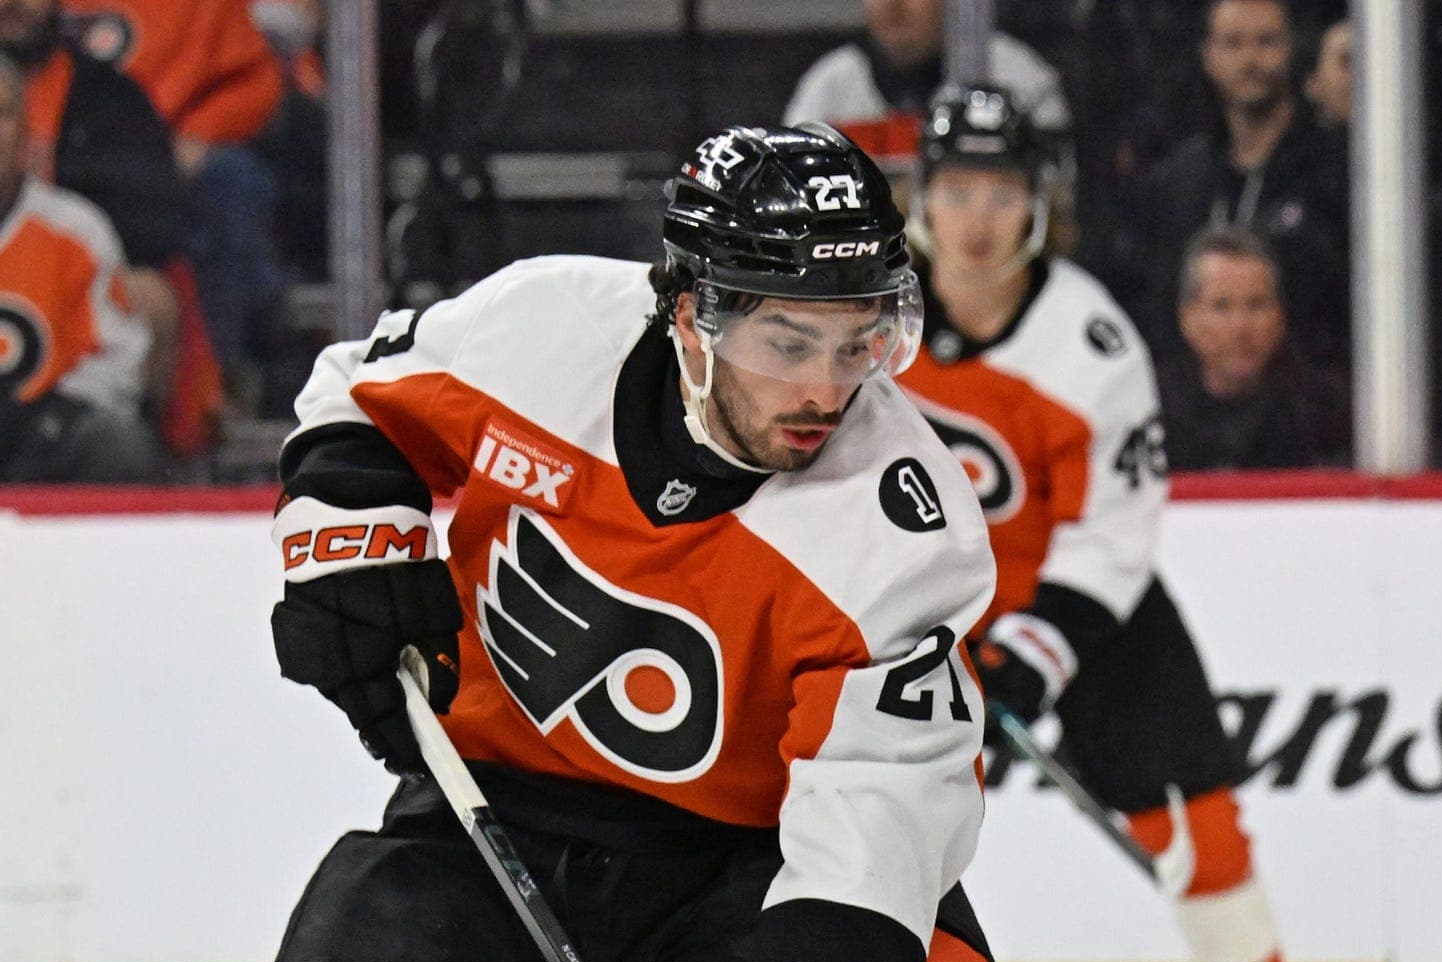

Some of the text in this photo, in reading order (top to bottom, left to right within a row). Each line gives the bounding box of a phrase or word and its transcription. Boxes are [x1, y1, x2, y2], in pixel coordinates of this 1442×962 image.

[808, 174, 861, 211] 27
[812, 241, 880, 260] CCM
[487, 423, 562, 468] Independence
[473, 434, 571, 509] IBX
[282, 524, 429, 572] CCM
